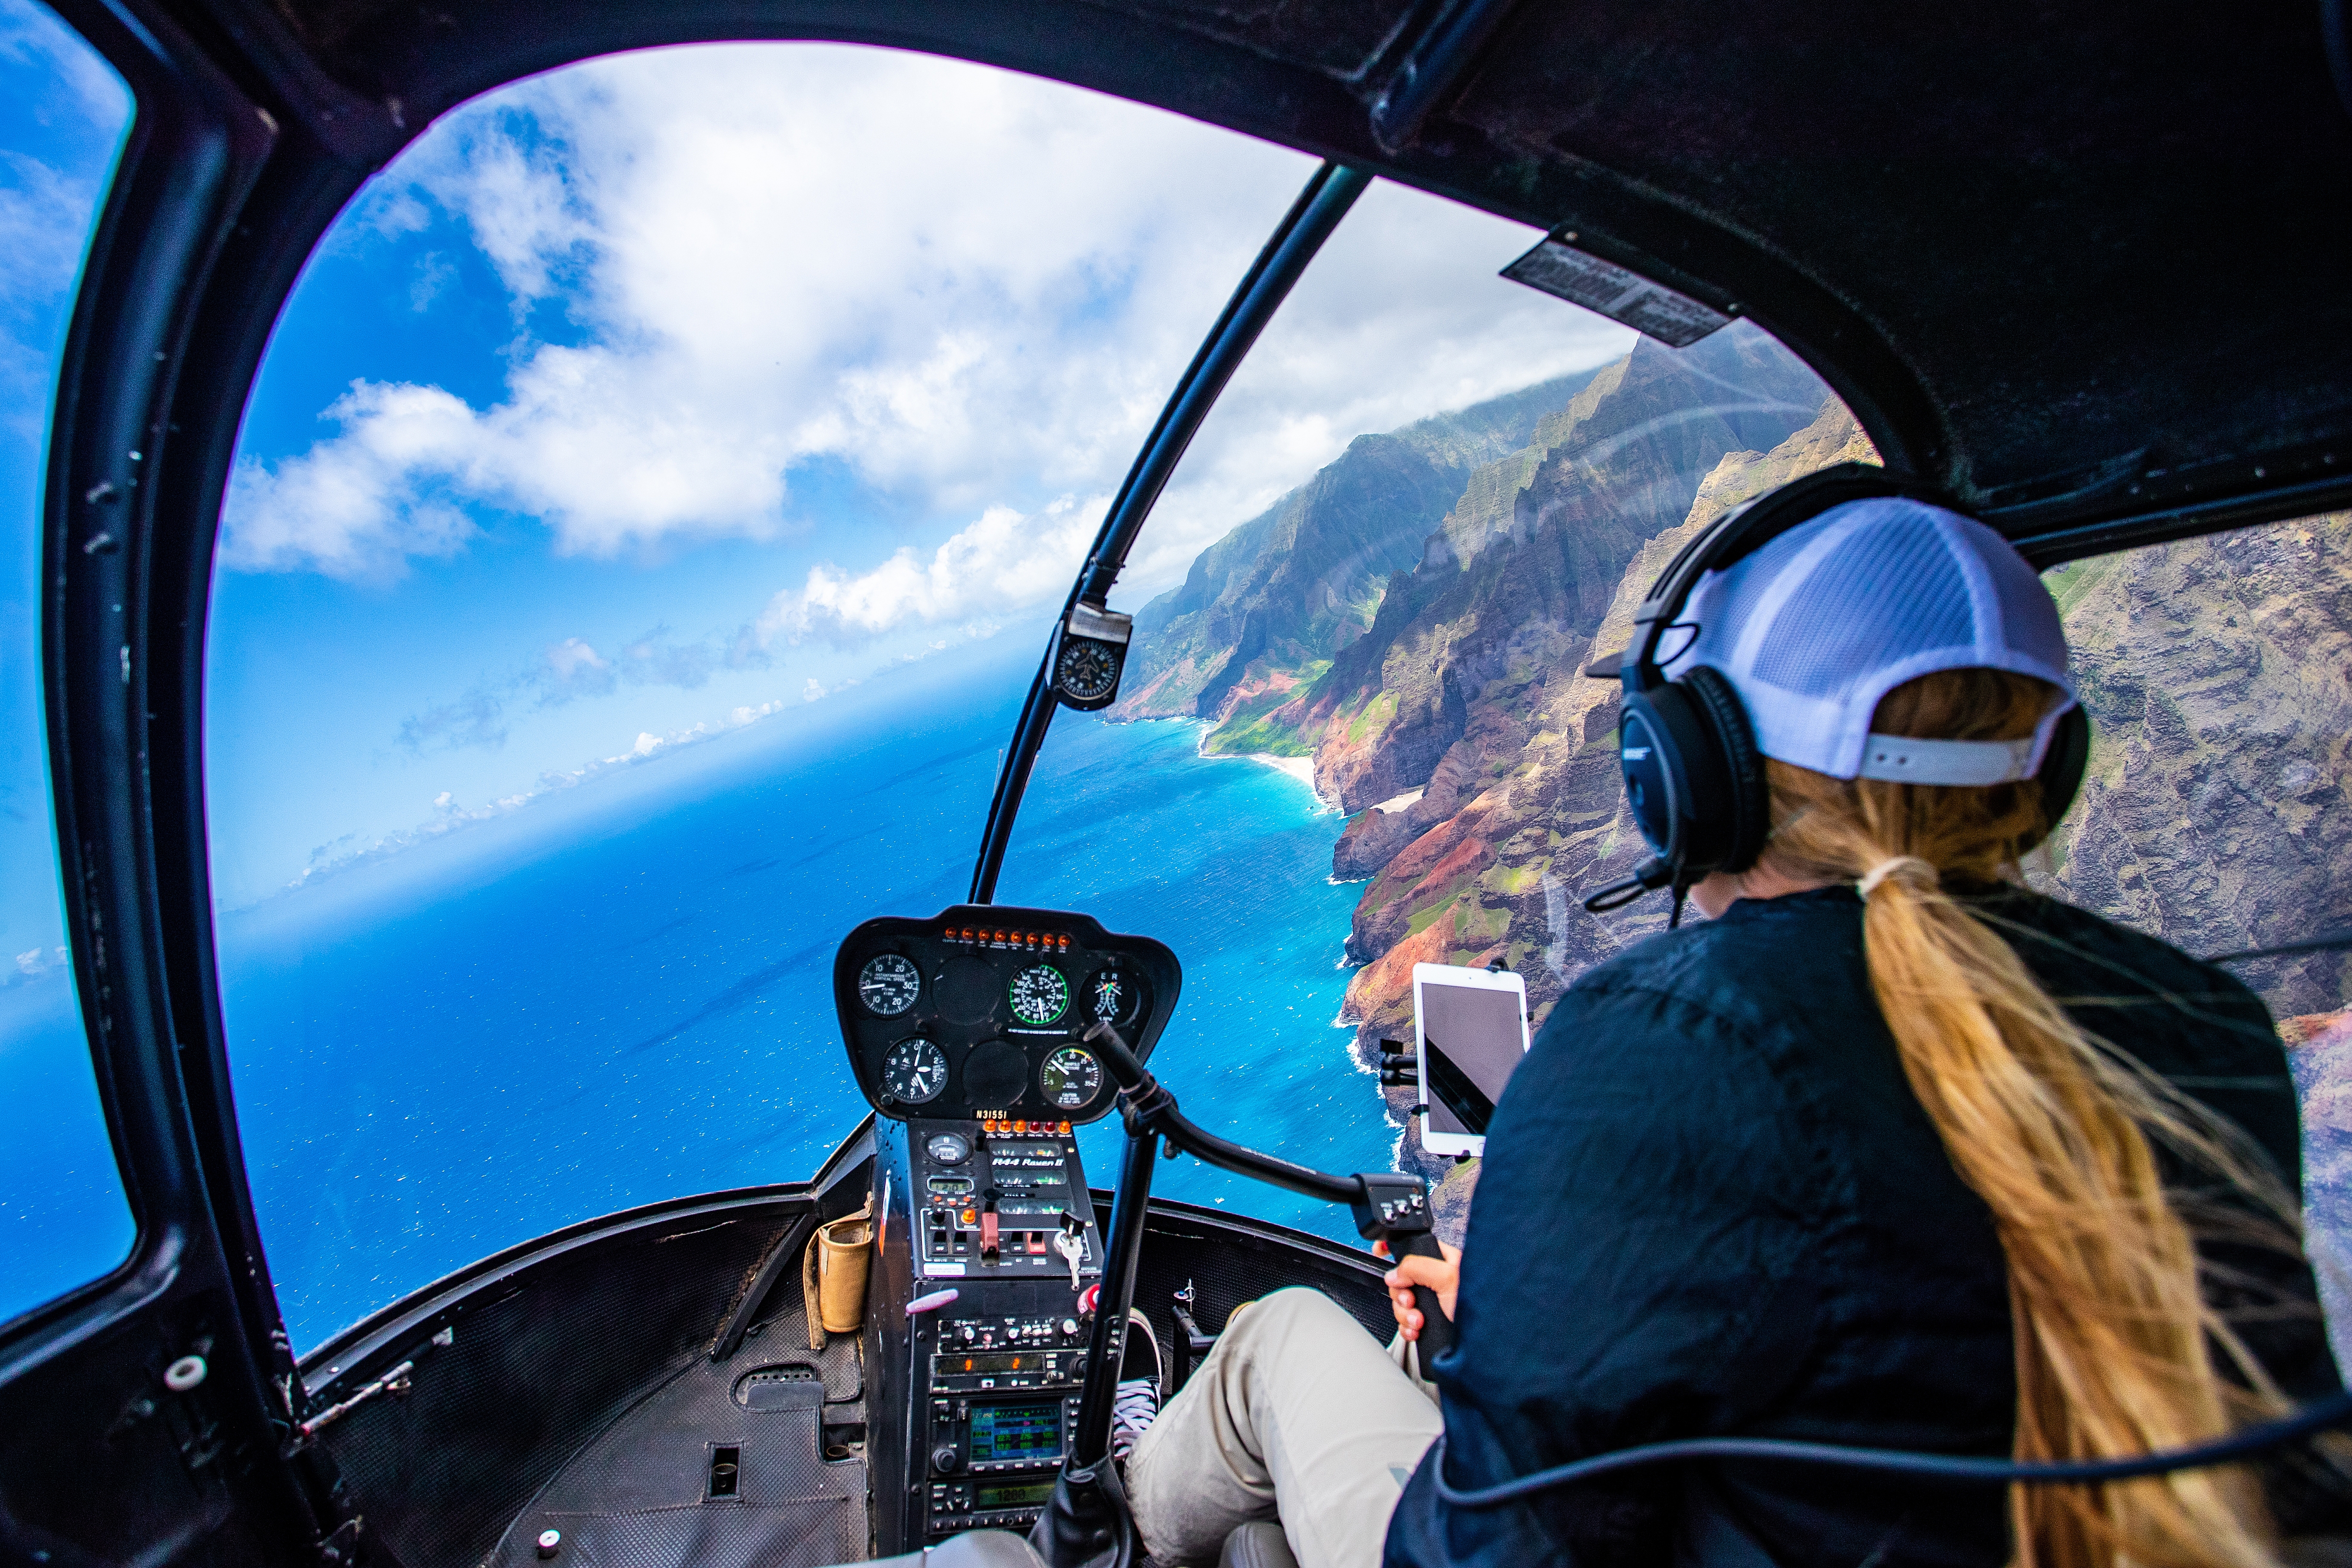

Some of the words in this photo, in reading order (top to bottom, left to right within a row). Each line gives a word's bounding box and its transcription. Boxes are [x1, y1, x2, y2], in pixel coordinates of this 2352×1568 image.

[892, 997, 902, 1005] 20
[976, 1110, 1007, 1119] N31551
[1022, 1158, 1054, 1166] Raven
